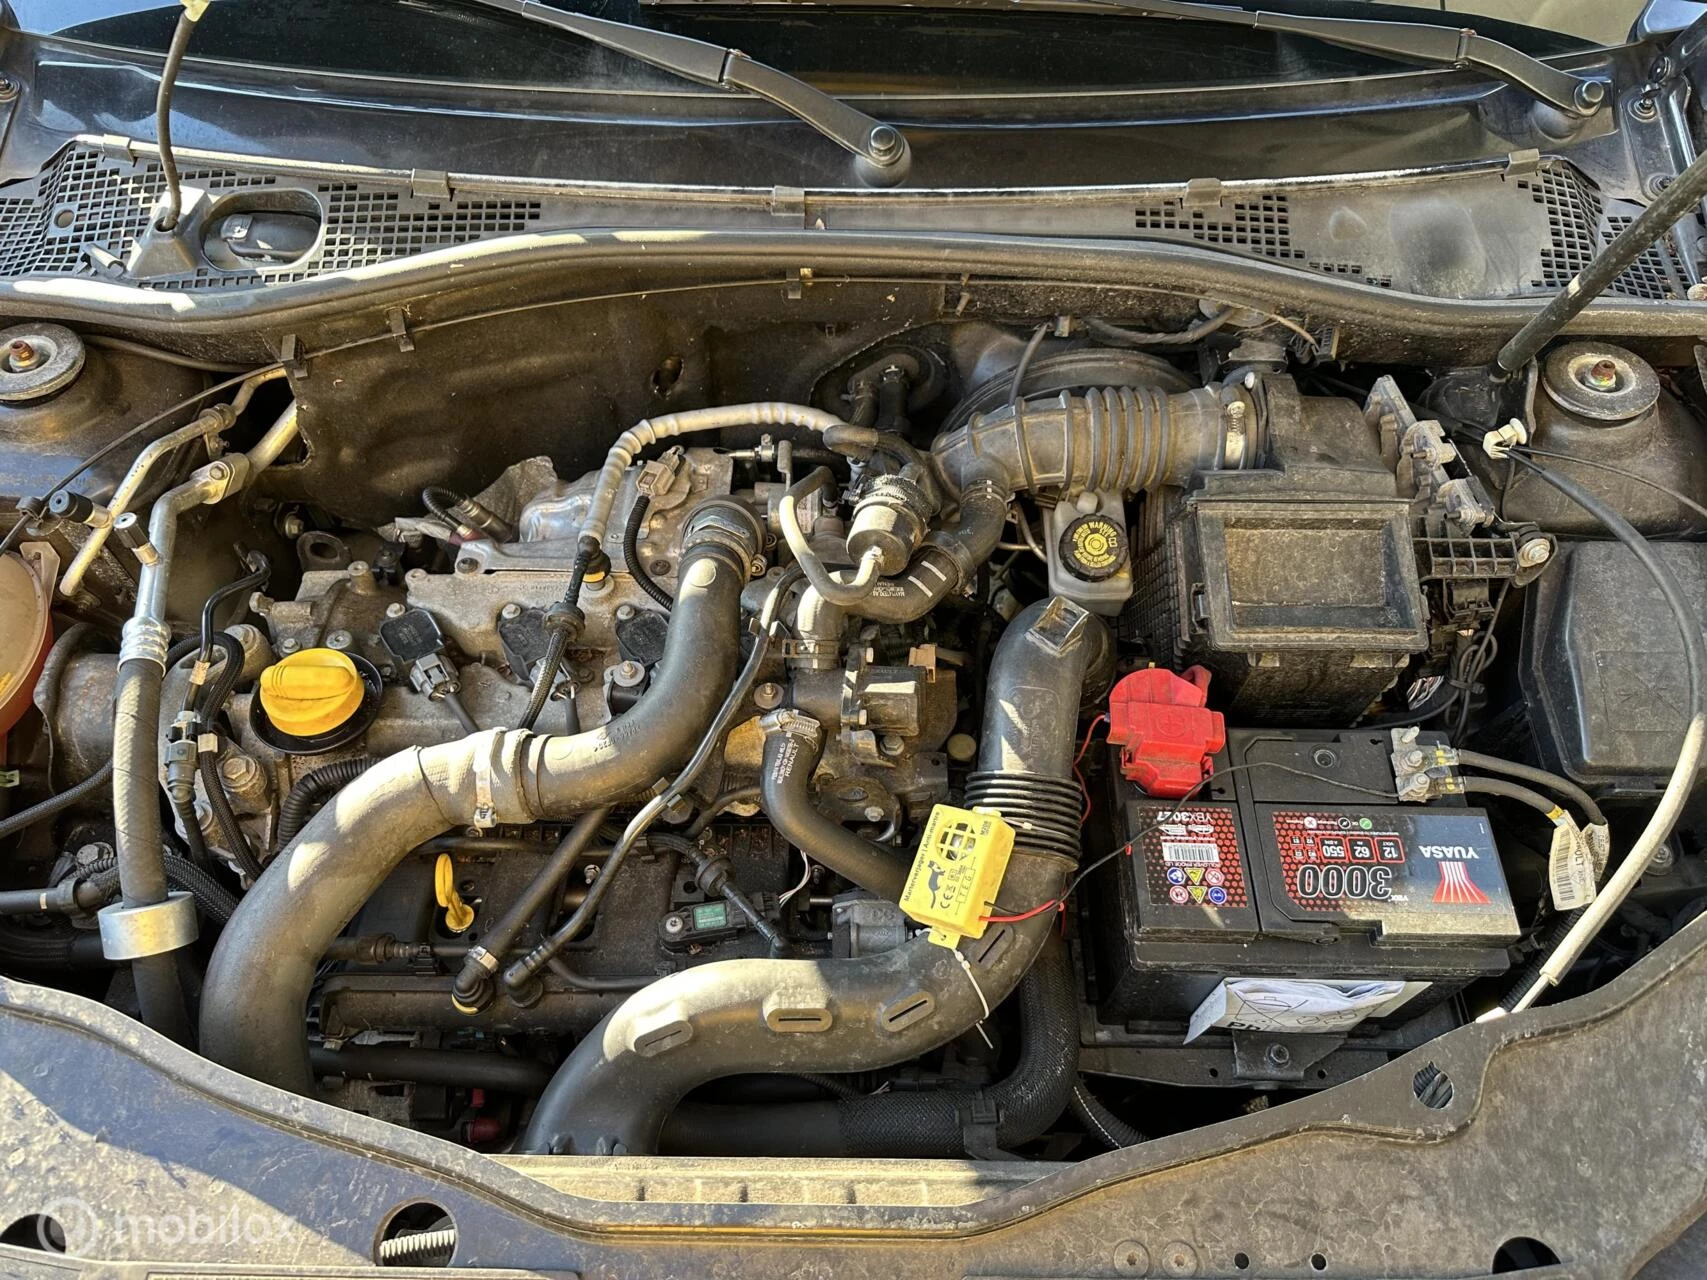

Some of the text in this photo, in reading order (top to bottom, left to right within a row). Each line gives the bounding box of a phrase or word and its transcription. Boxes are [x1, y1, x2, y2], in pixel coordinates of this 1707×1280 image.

[784, 743, 800, 777] RENAULT
[1322, 845, 1345, 857] 550
[1354, 846, 1370, 857] 62
[1383, 846, 1398, 858] 12
[1418, 845, 1479, 859] YUASA
[1296, 865, 1393, 899] 3000
